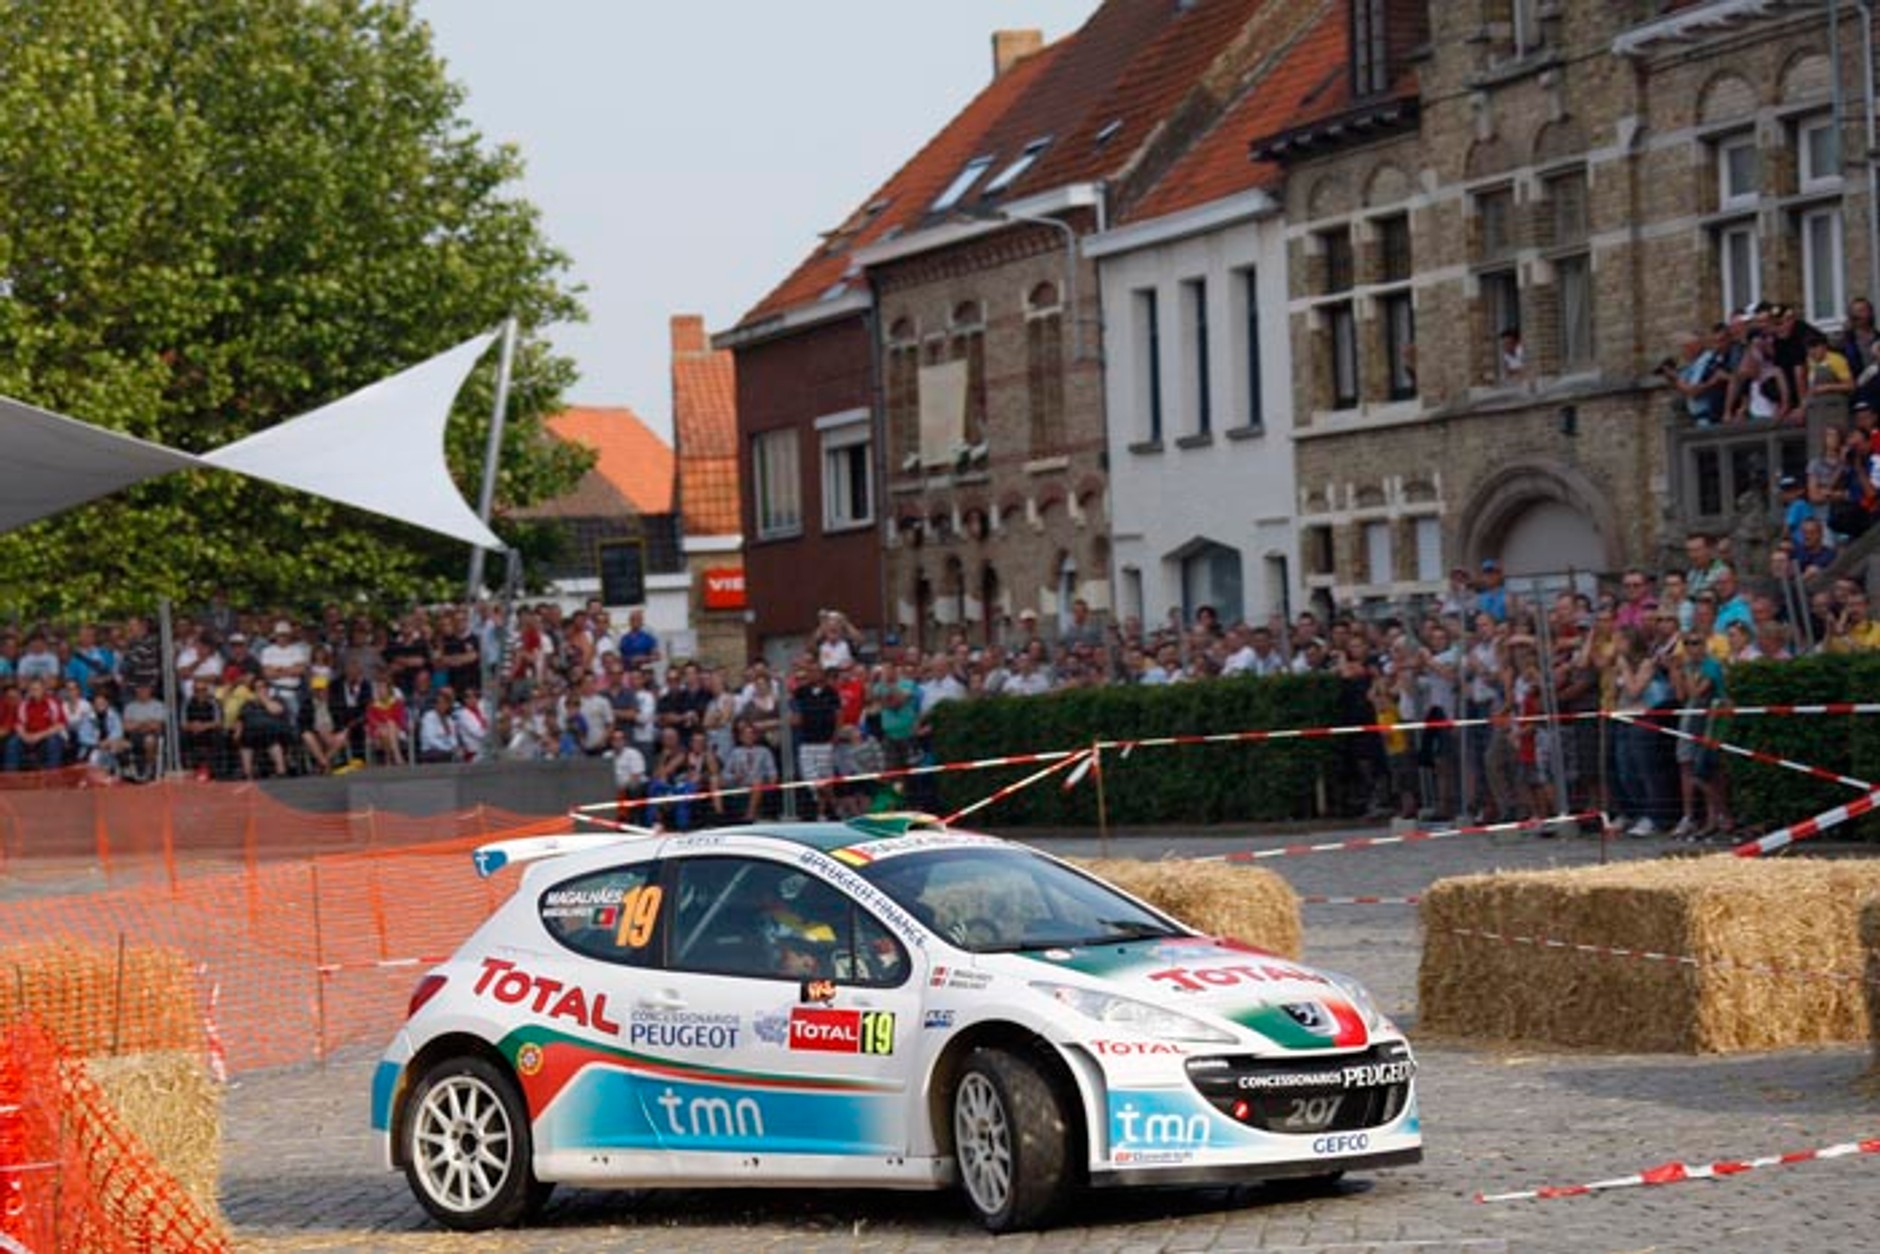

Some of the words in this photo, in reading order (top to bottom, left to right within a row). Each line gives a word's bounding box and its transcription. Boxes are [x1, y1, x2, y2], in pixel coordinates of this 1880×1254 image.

[615, 885, 663, 948] 19
[473, 957, 620, 1036] TOTAL
[631, 1022, 740, 1049] PEUGEOT
[792, 1020, 858, 1041] TOTAL
[864, 1013, 893, 1053] 19
[1092, 1040, 1189, 1056] TOTAL
[658, 1087, 764, 1136] tmn
[1116, 1103, 1211, 1144] tmn
[1287, 1097, 1343, 1127] 207
[1313, 1133, 1369, 1153] GEFCO
